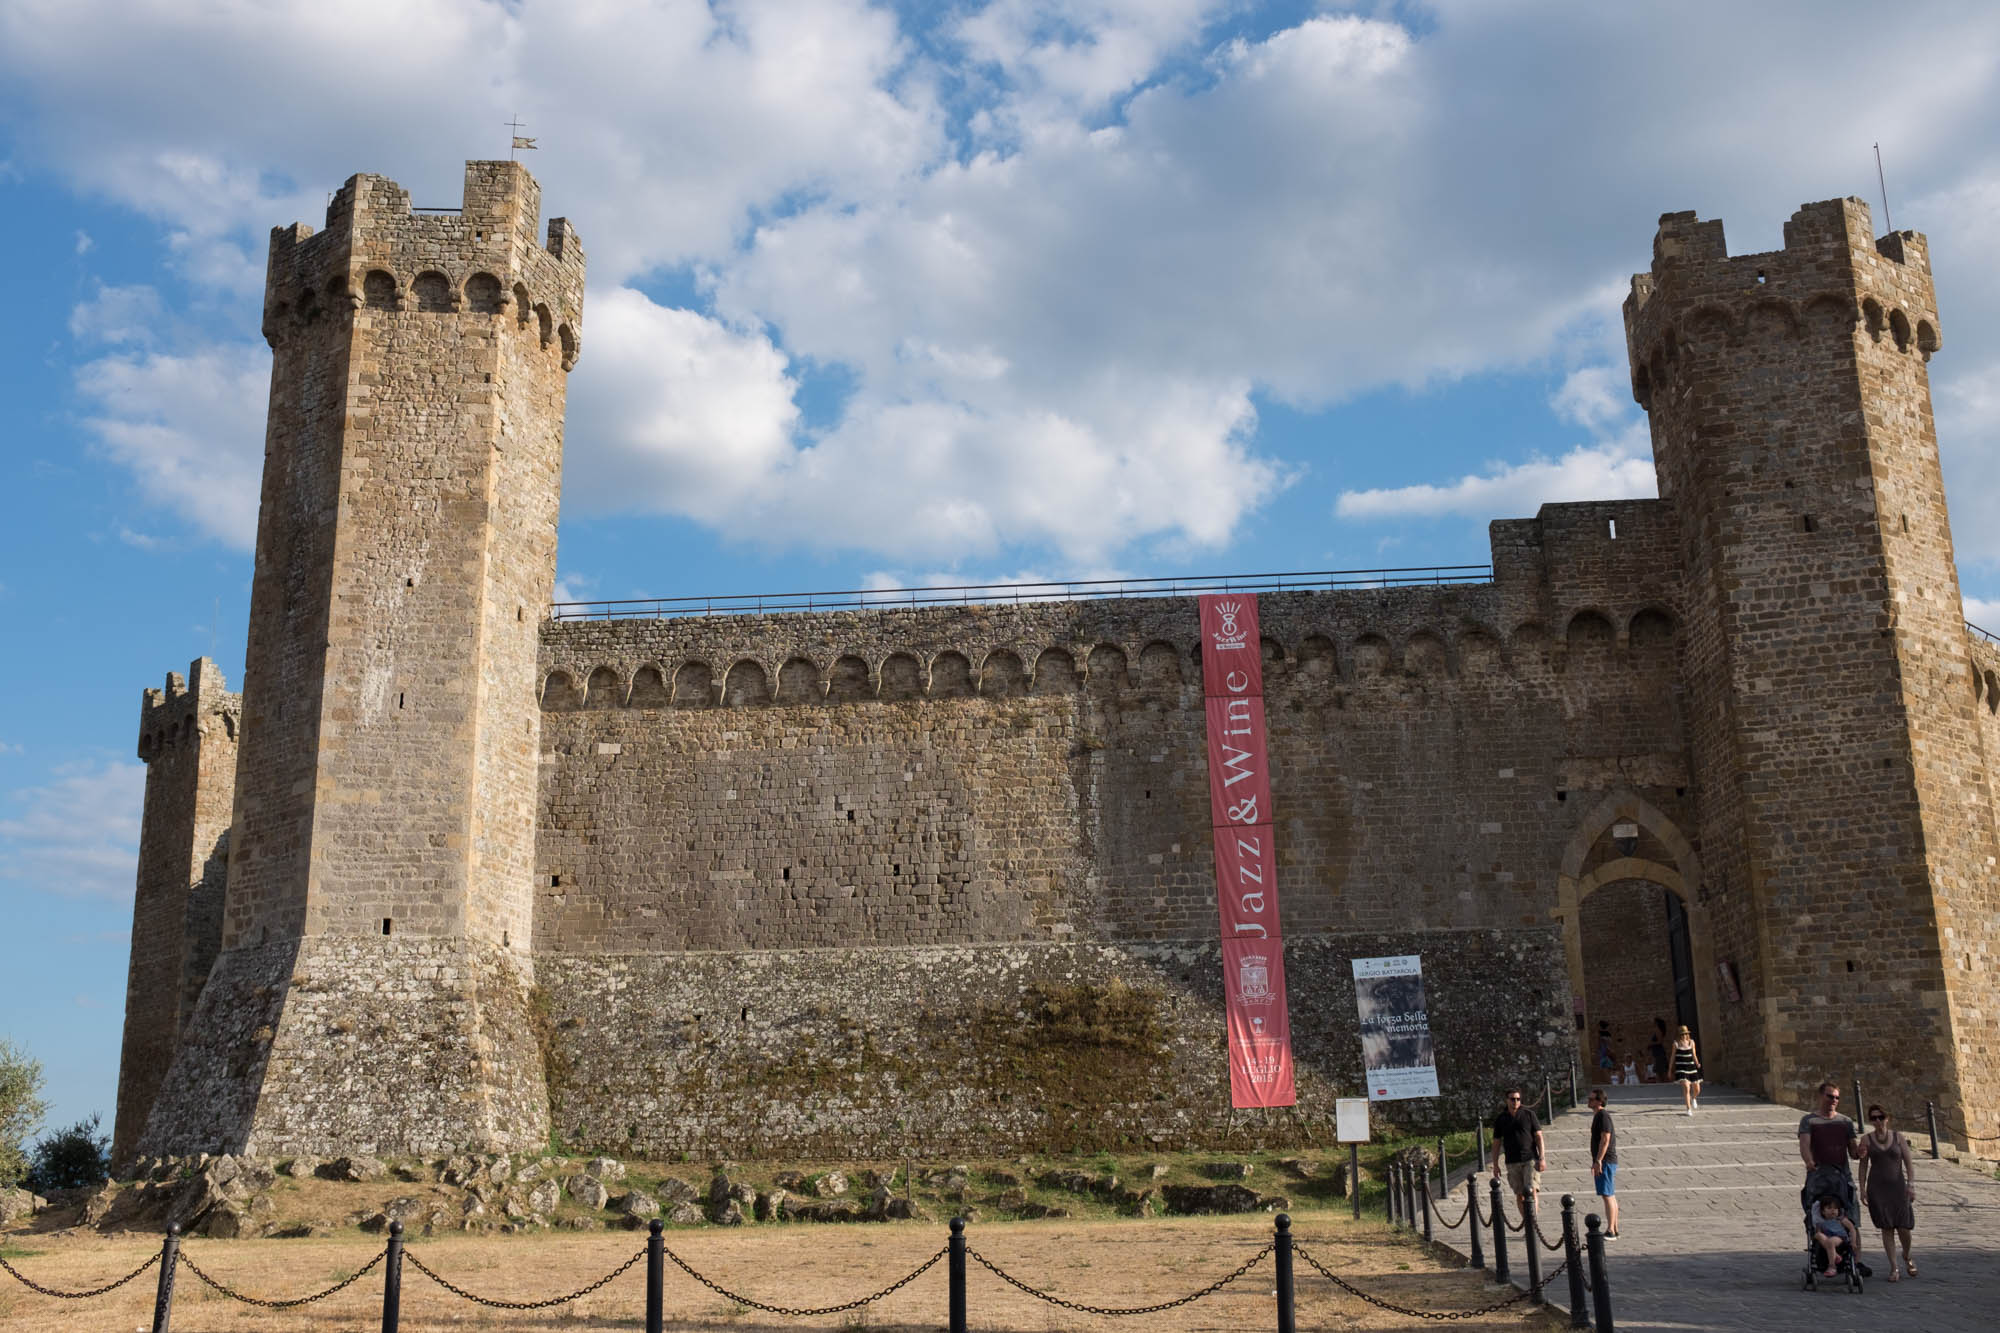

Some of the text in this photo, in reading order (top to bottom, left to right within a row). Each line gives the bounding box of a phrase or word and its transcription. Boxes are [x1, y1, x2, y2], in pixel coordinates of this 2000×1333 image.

[1222, 670, 1255, 788] Wine
[1227, 795, 1258, 825] &
[1234, 837, 1268, 940] Jazz
[1360, 1010, 1427, 1025] La forza della
[1386, 1023, 1428, 1033] memoria
[1242, 1065, 1281, 1074] LUGLIO
[1251, 1074, 1273, 1083] 2015
